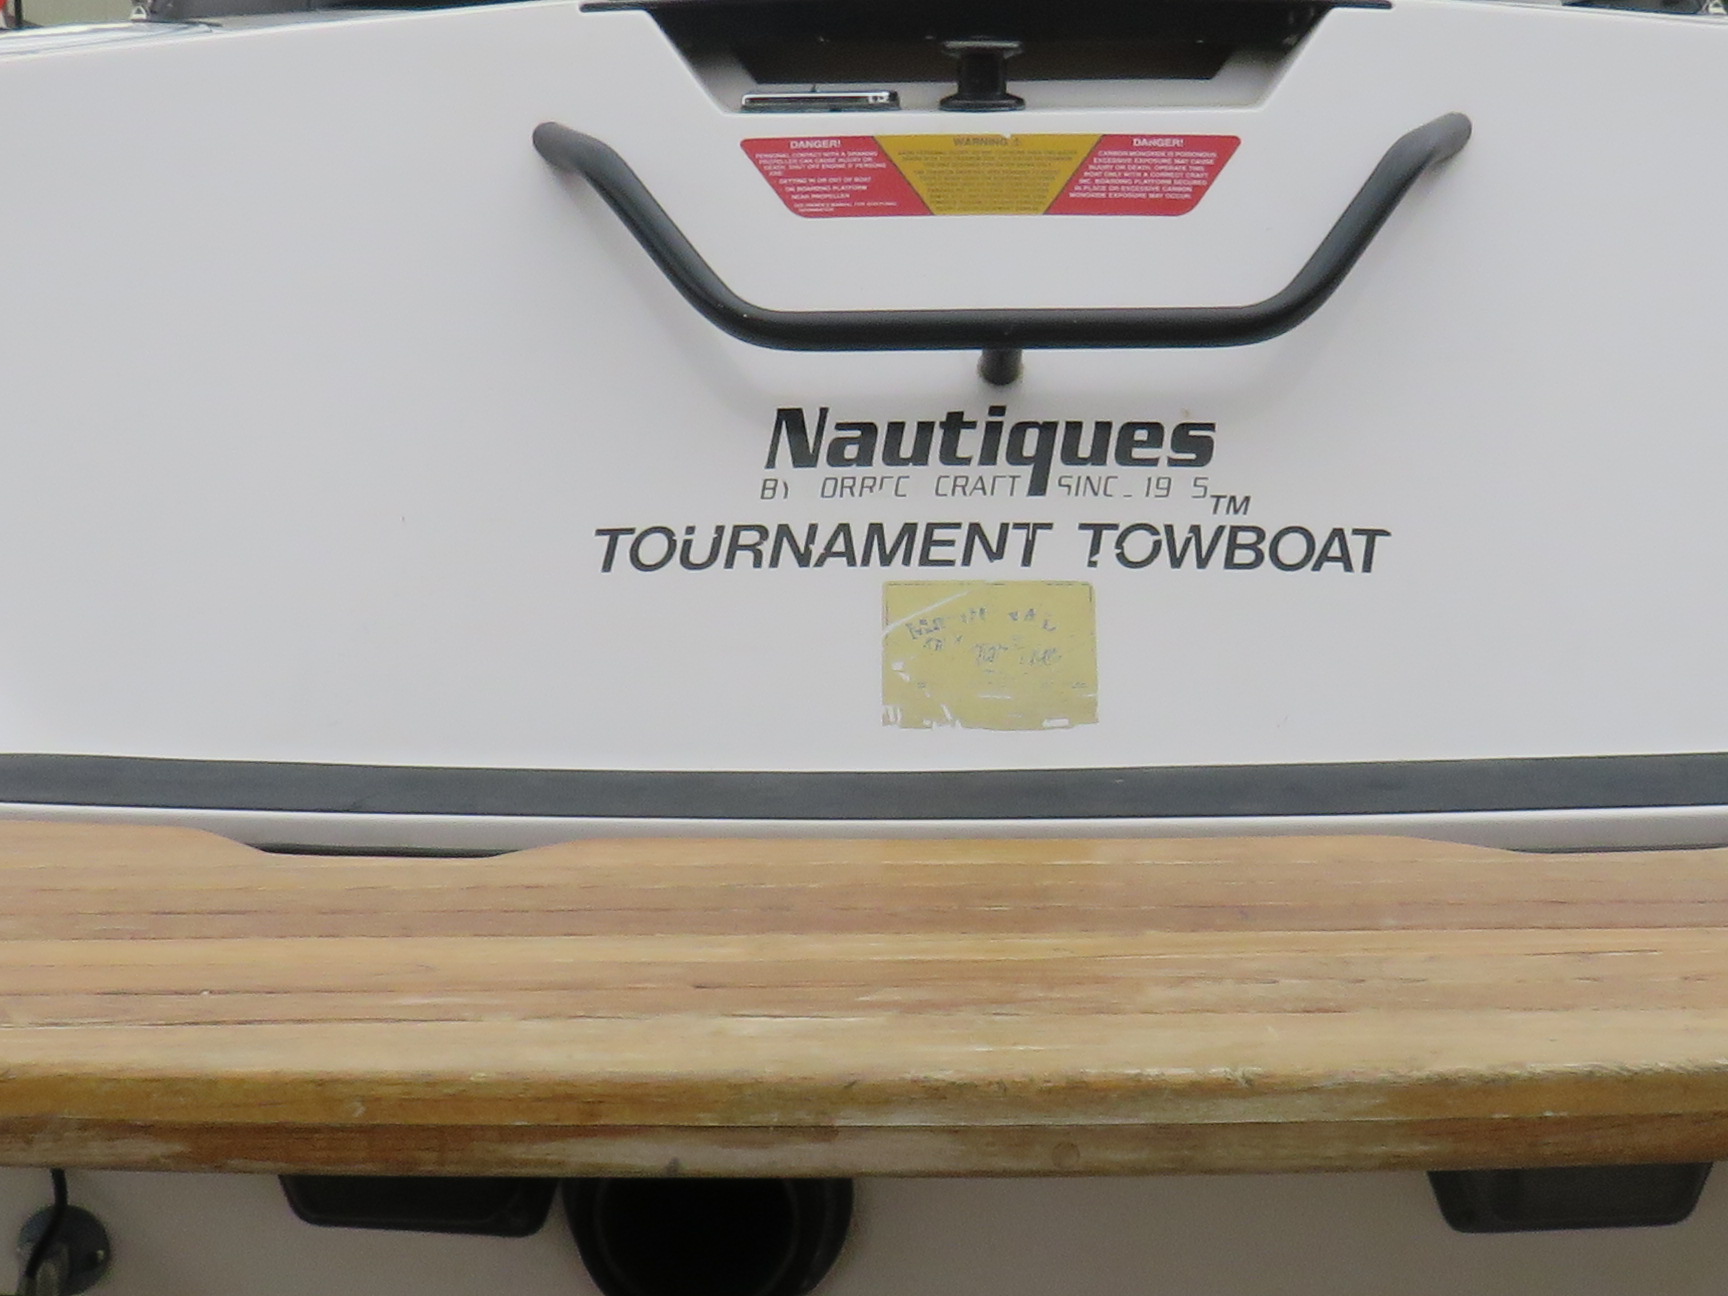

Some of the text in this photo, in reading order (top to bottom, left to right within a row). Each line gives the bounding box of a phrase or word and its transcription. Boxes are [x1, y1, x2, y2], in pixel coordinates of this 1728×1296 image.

[790, 140, 841, 149] DANGER!
[953, 137, 1008, 147] WARNING
[1133, 138, 1183, 148] DANGER!
[764, 405, 1216, 497] Nautiques
[1056, 475, 1134, 498] SINC
[1144, 475, 1210, 499] 195
[594, 522, 1392, 574] TOURNAMENT TOWBOAT
